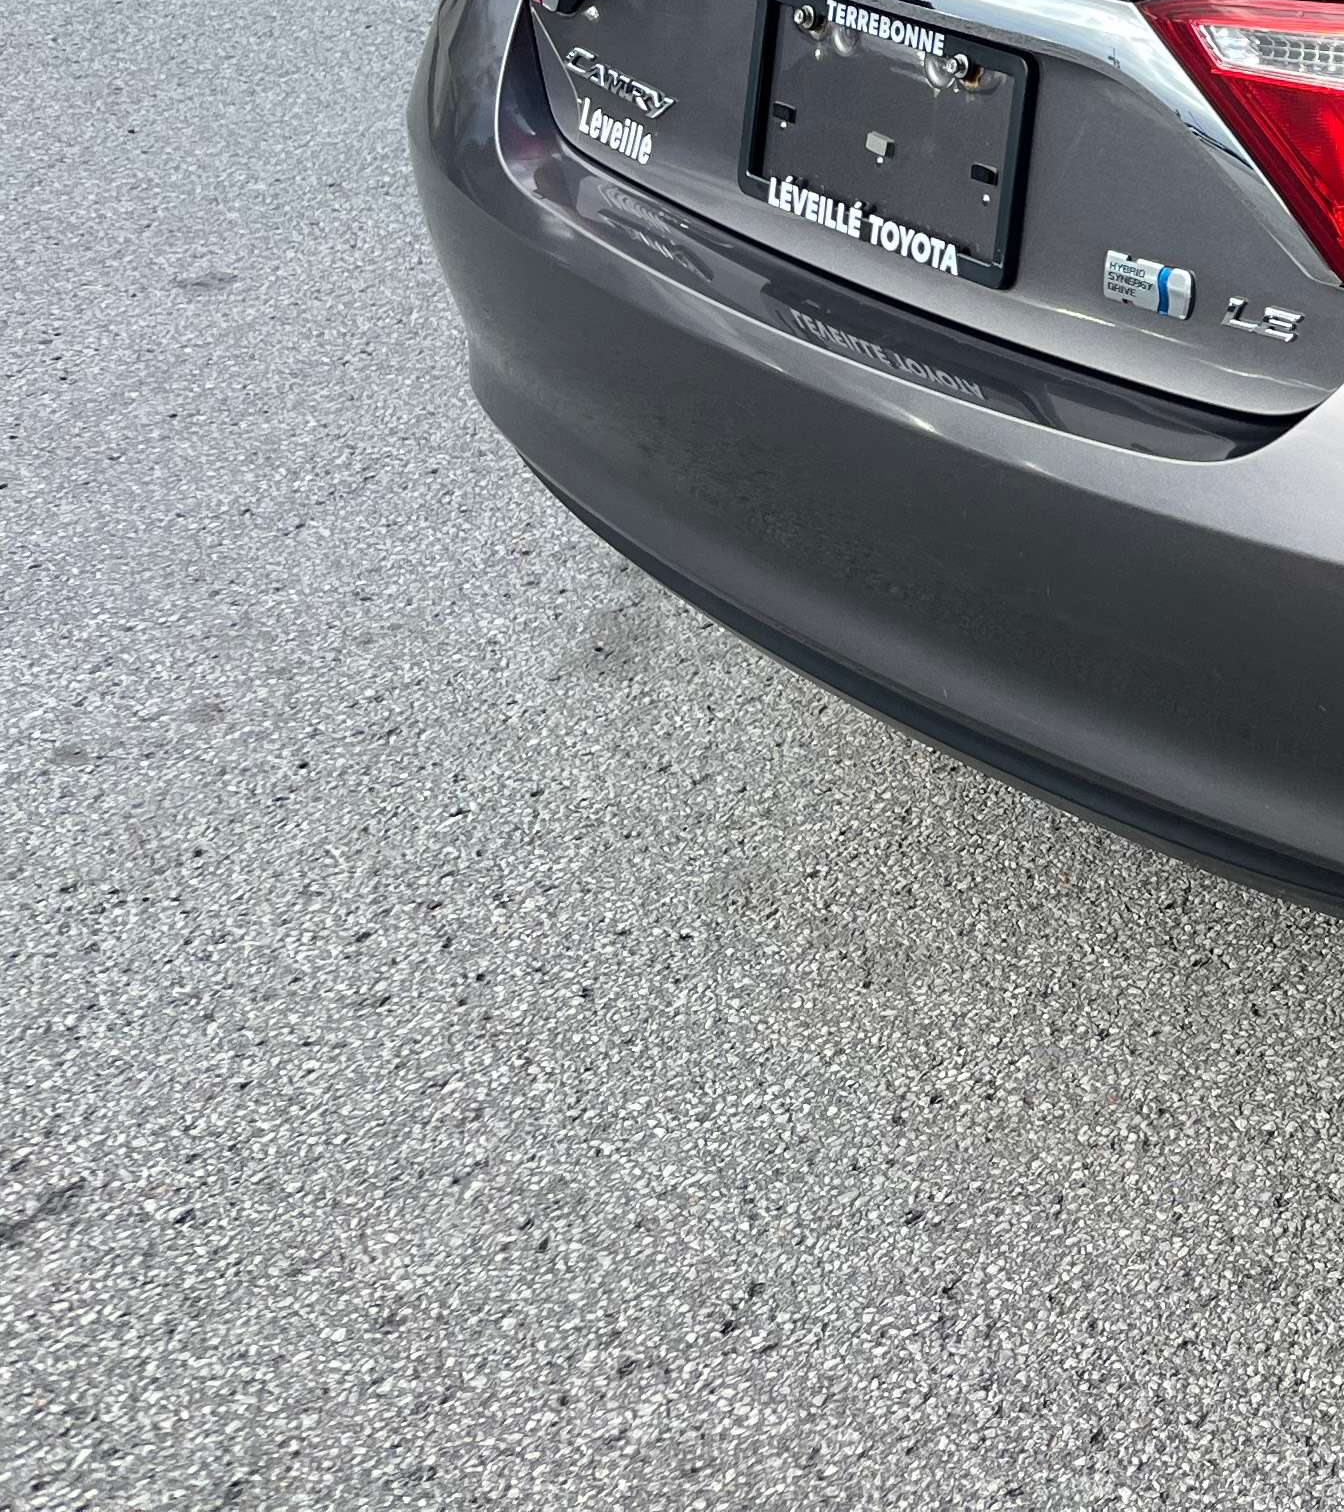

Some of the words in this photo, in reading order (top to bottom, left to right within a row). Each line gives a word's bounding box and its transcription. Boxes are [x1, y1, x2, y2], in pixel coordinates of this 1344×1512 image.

[826, 0, 945, 56] TERREBONNE
[767, 175, 863, 238] LÉVEILLÉ
[868, 214, 959, 276] TOYOTA
[1107, 281, 1137, 298] DRIVE
[1109, 261, 1146, 279] HYBRID
[1221, 295, 1305, 343] LE
